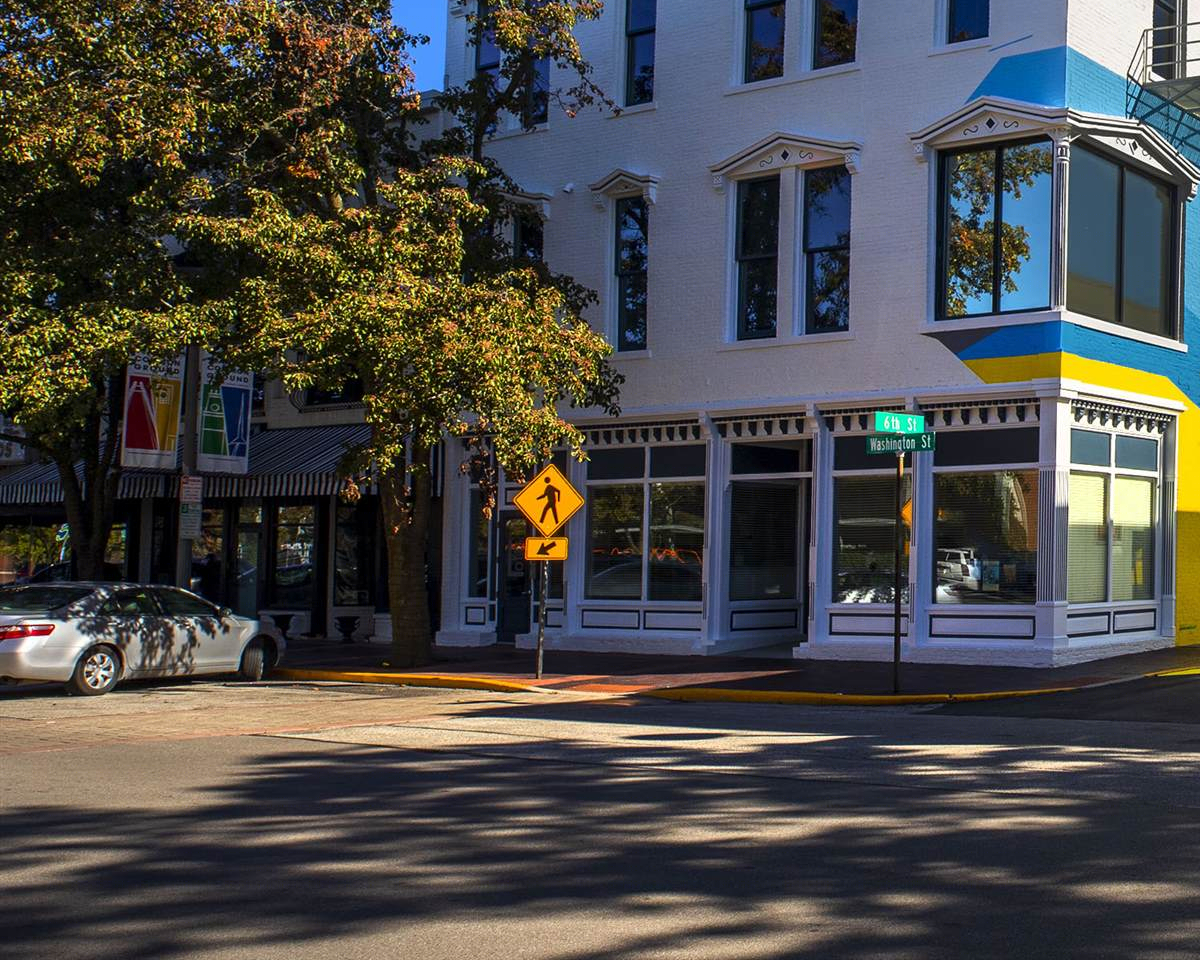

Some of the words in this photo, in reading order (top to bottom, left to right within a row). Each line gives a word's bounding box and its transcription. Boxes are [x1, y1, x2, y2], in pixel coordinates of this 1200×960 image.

[207, 372, 249, 383] GOUND
[884, 416, 900, 430] 6th
[907, 417, 917, 432] St
[870, 436, 915, 452] Washington
[921, 434, 931, 449] St
